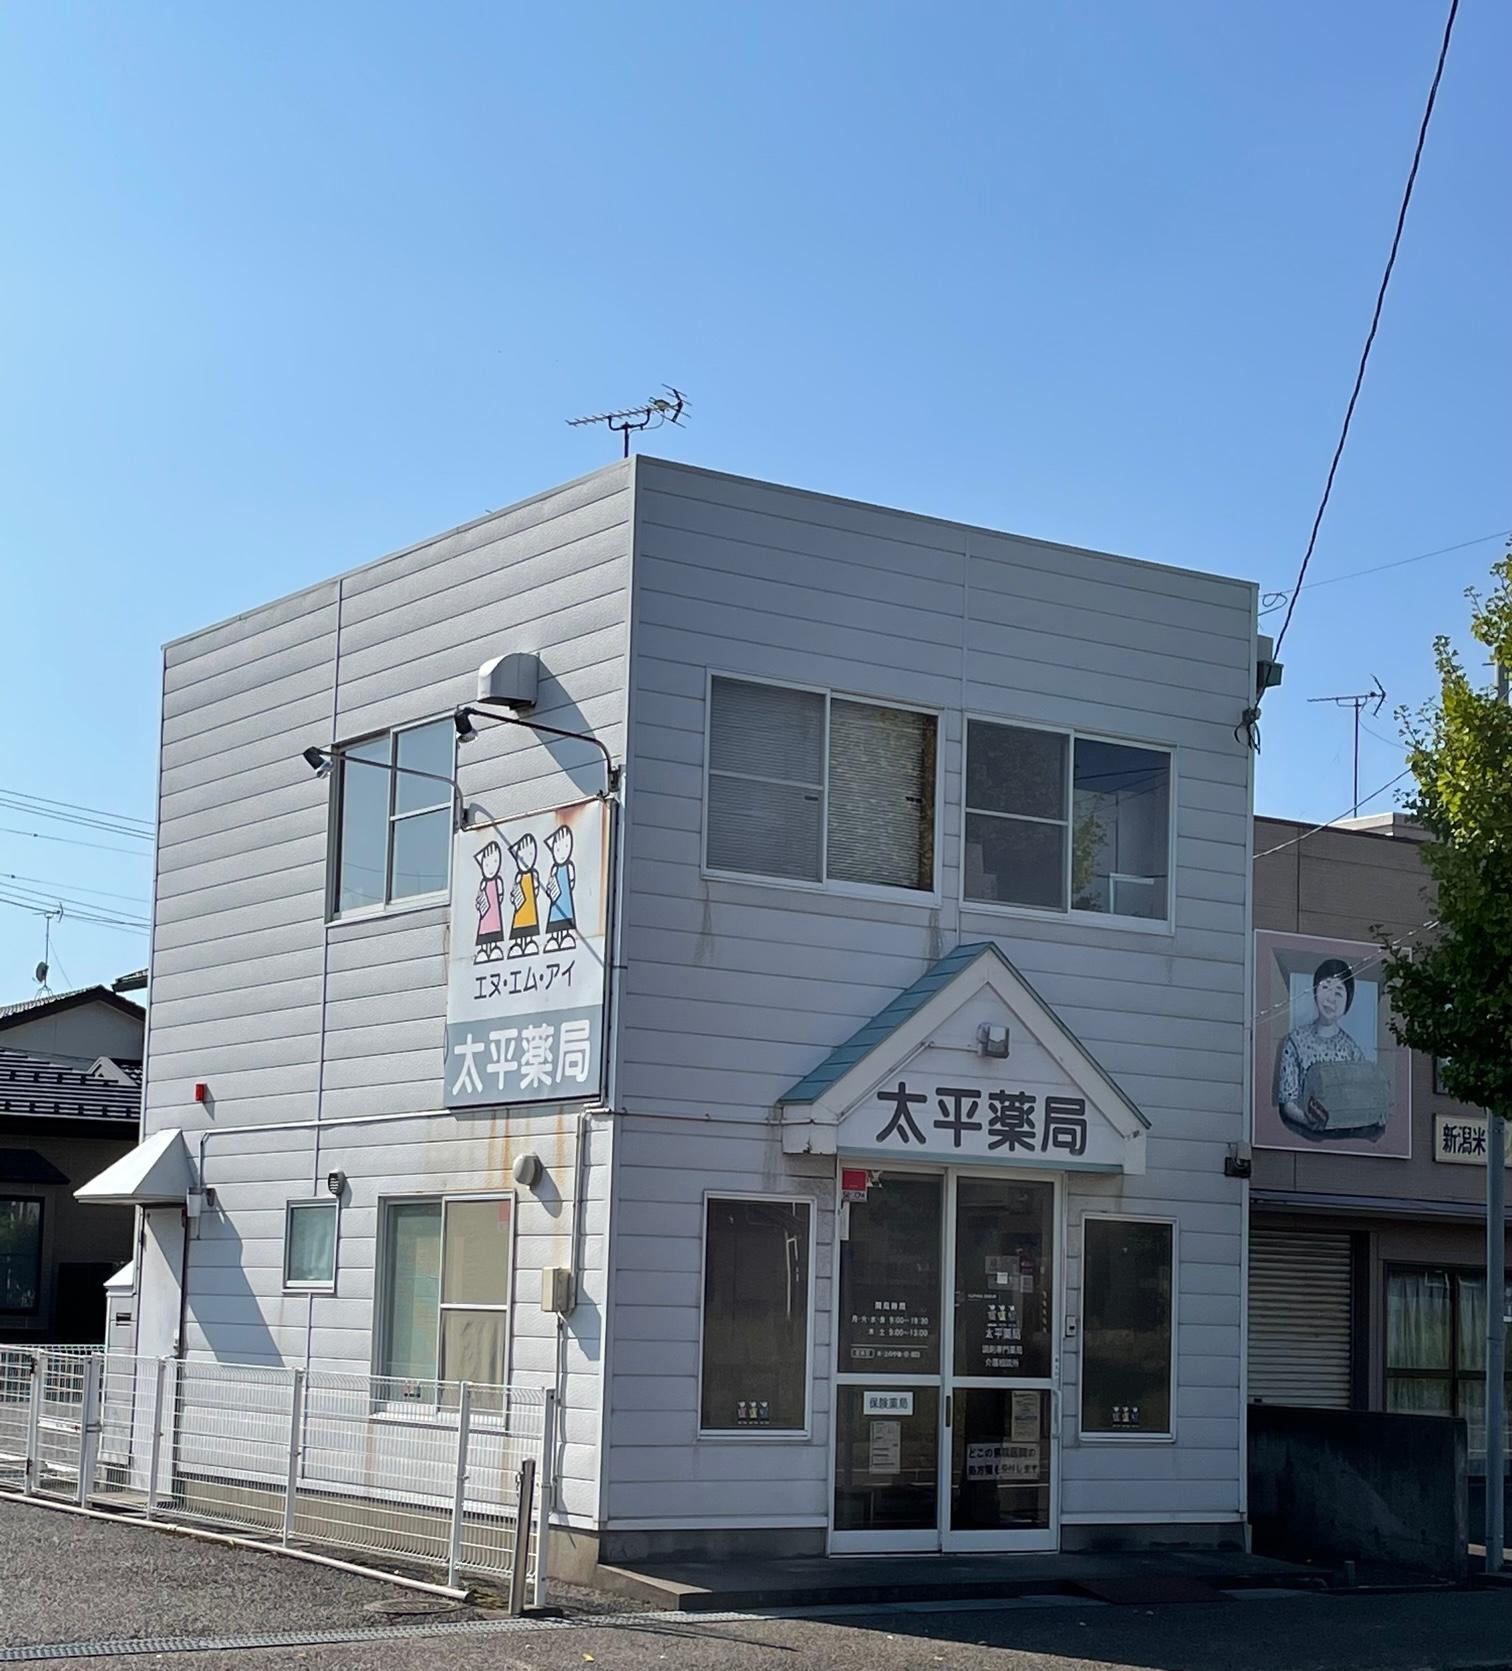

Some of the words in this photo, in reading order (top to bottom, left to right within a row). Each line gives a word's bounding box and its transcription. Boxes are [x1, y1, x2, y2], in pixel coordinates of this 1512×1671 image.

[473, 960, 576, 1000] エヌ・エム・アイ
[452, 1018, 591, 1097] 太平薬局
[875, 1081, 1087, 1156] 太平薬局
[1442, 1123, 1486, 1156] 新潟米
[869, 1397, 908, 1409] 保険薬局
